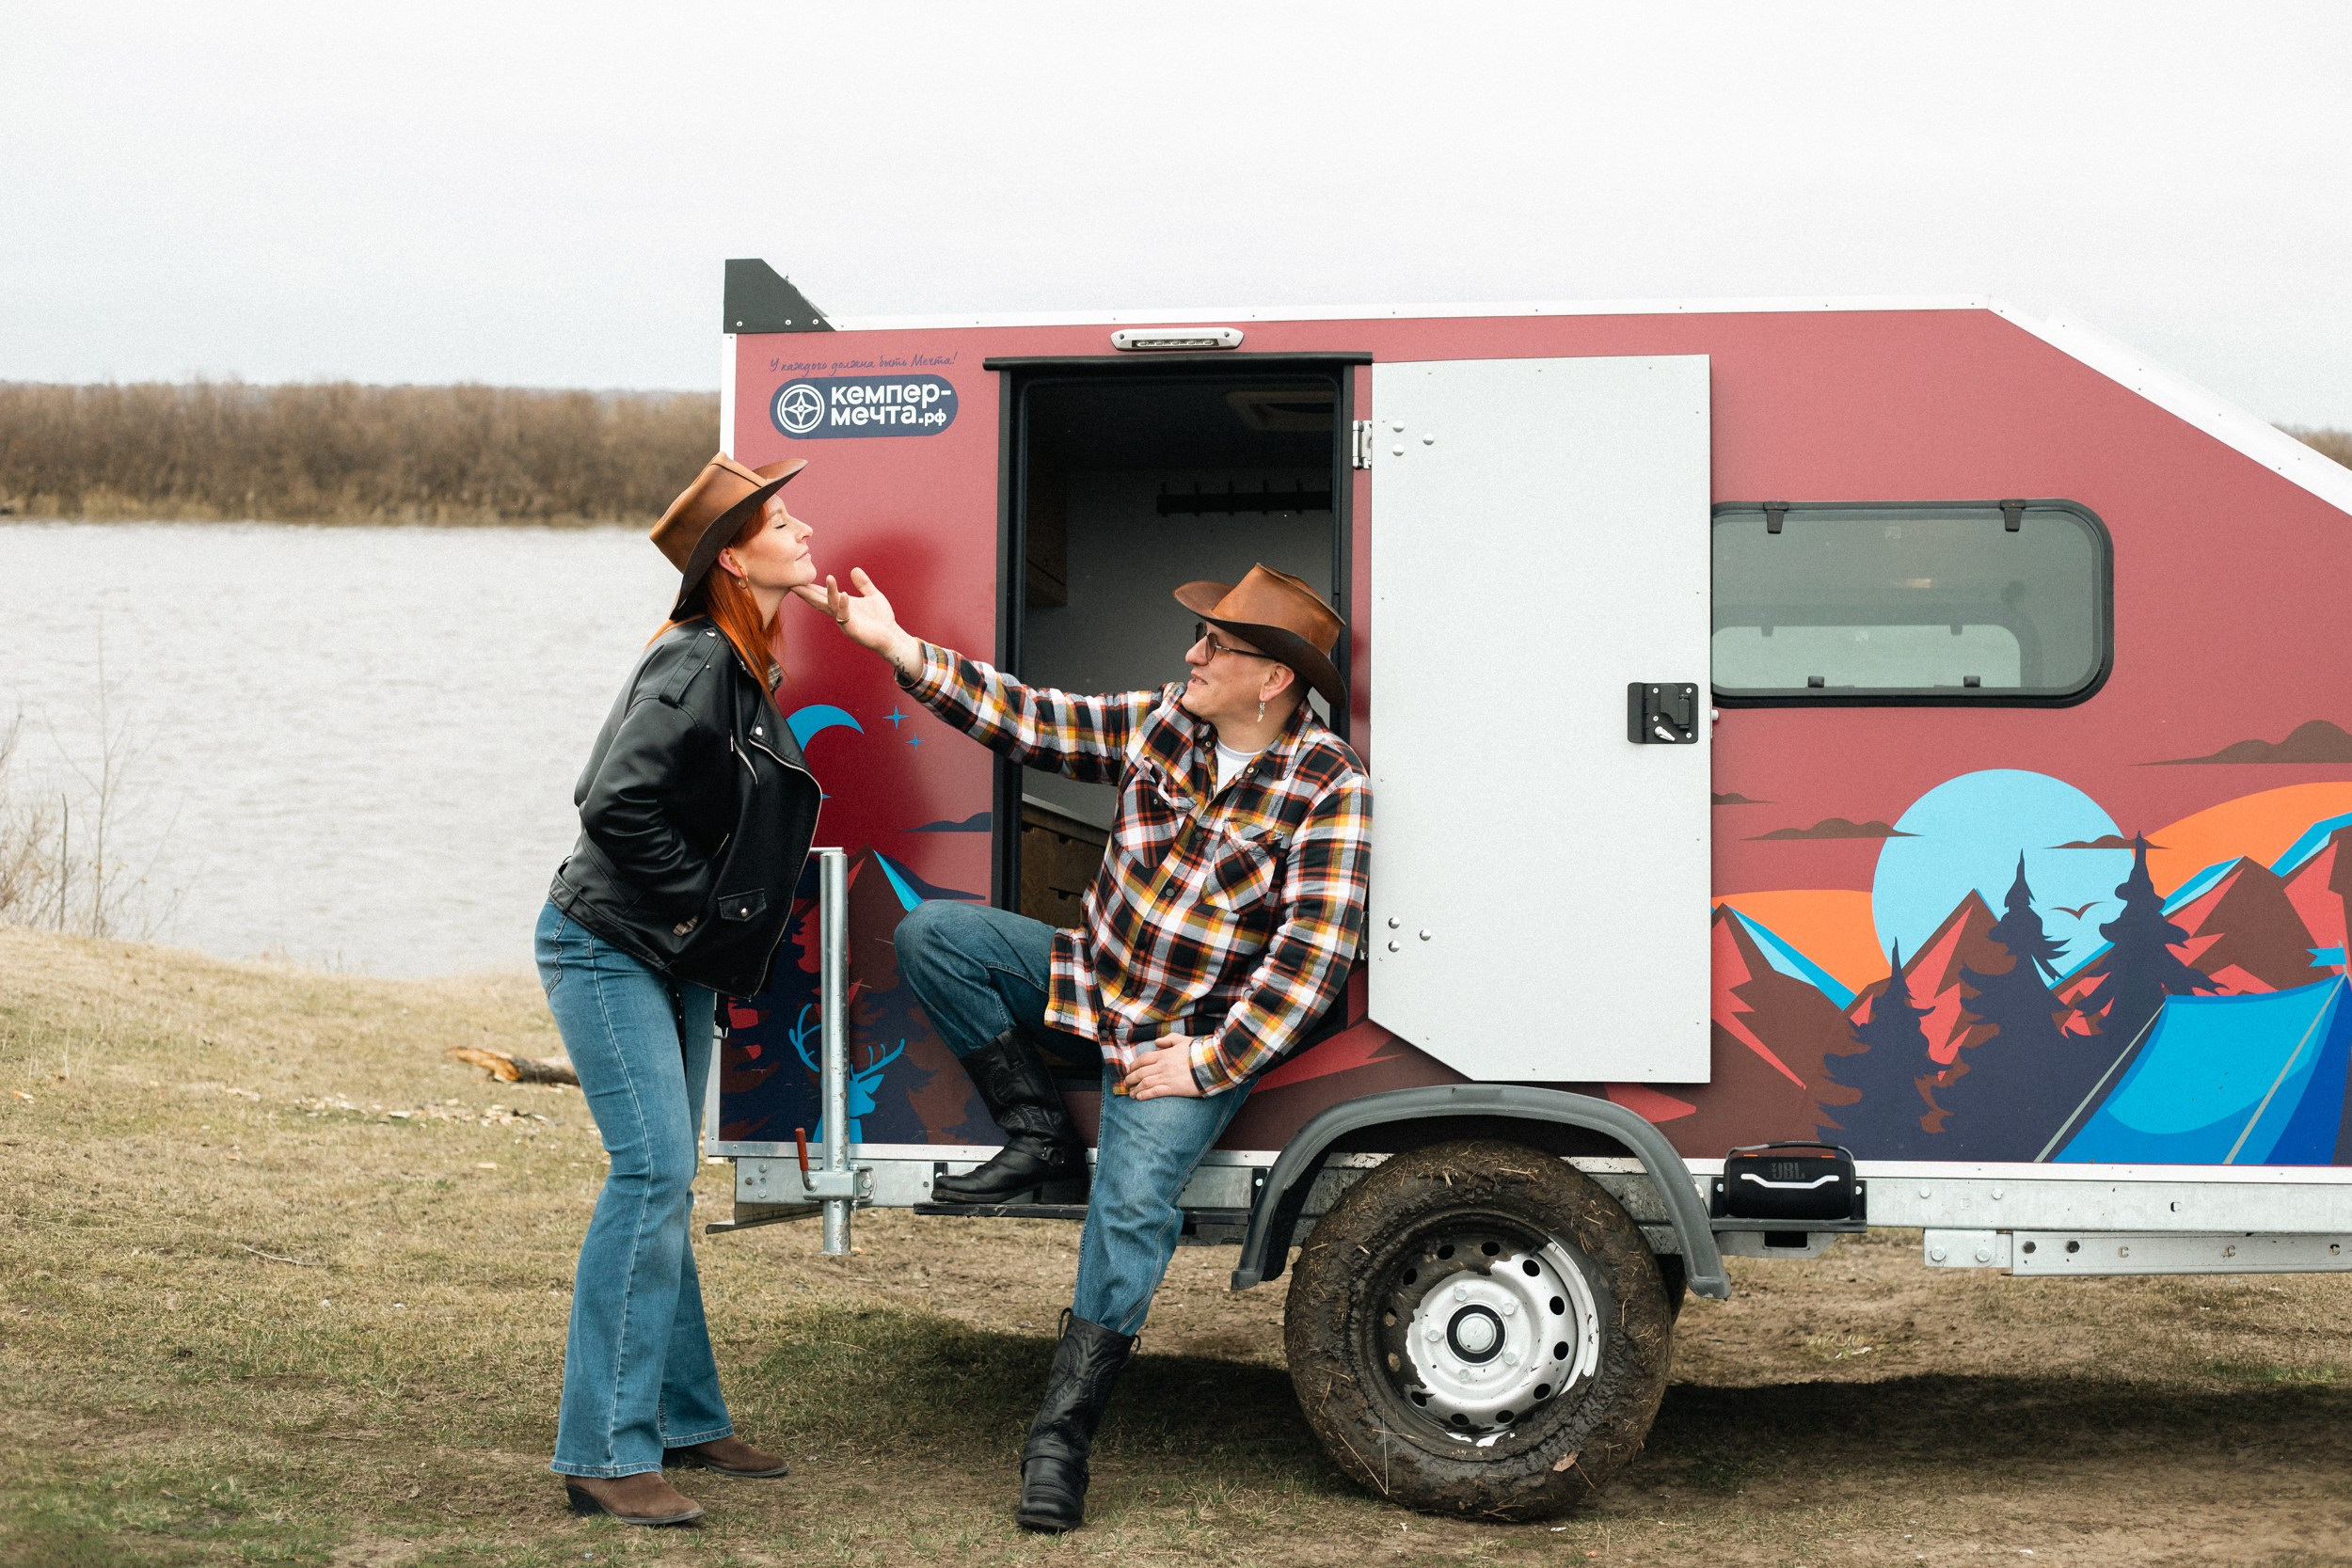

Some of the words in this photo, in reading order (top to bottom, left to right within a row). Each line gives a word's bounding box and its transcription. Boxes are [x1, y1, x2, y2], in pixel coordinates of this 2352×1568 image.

[770, 357, 780, 372] У
[781, 362, 828, 377] каждого
[829, 360, 875, 376] должна
[879, 355, 907, 368] быть
[911, 351, 958, 368] Мечта!
[831, 383, 952, 408] кемпер-
[831, 404, 946, 426] мечта.рф
[1772, 1162, 1805, 1180] JBL
